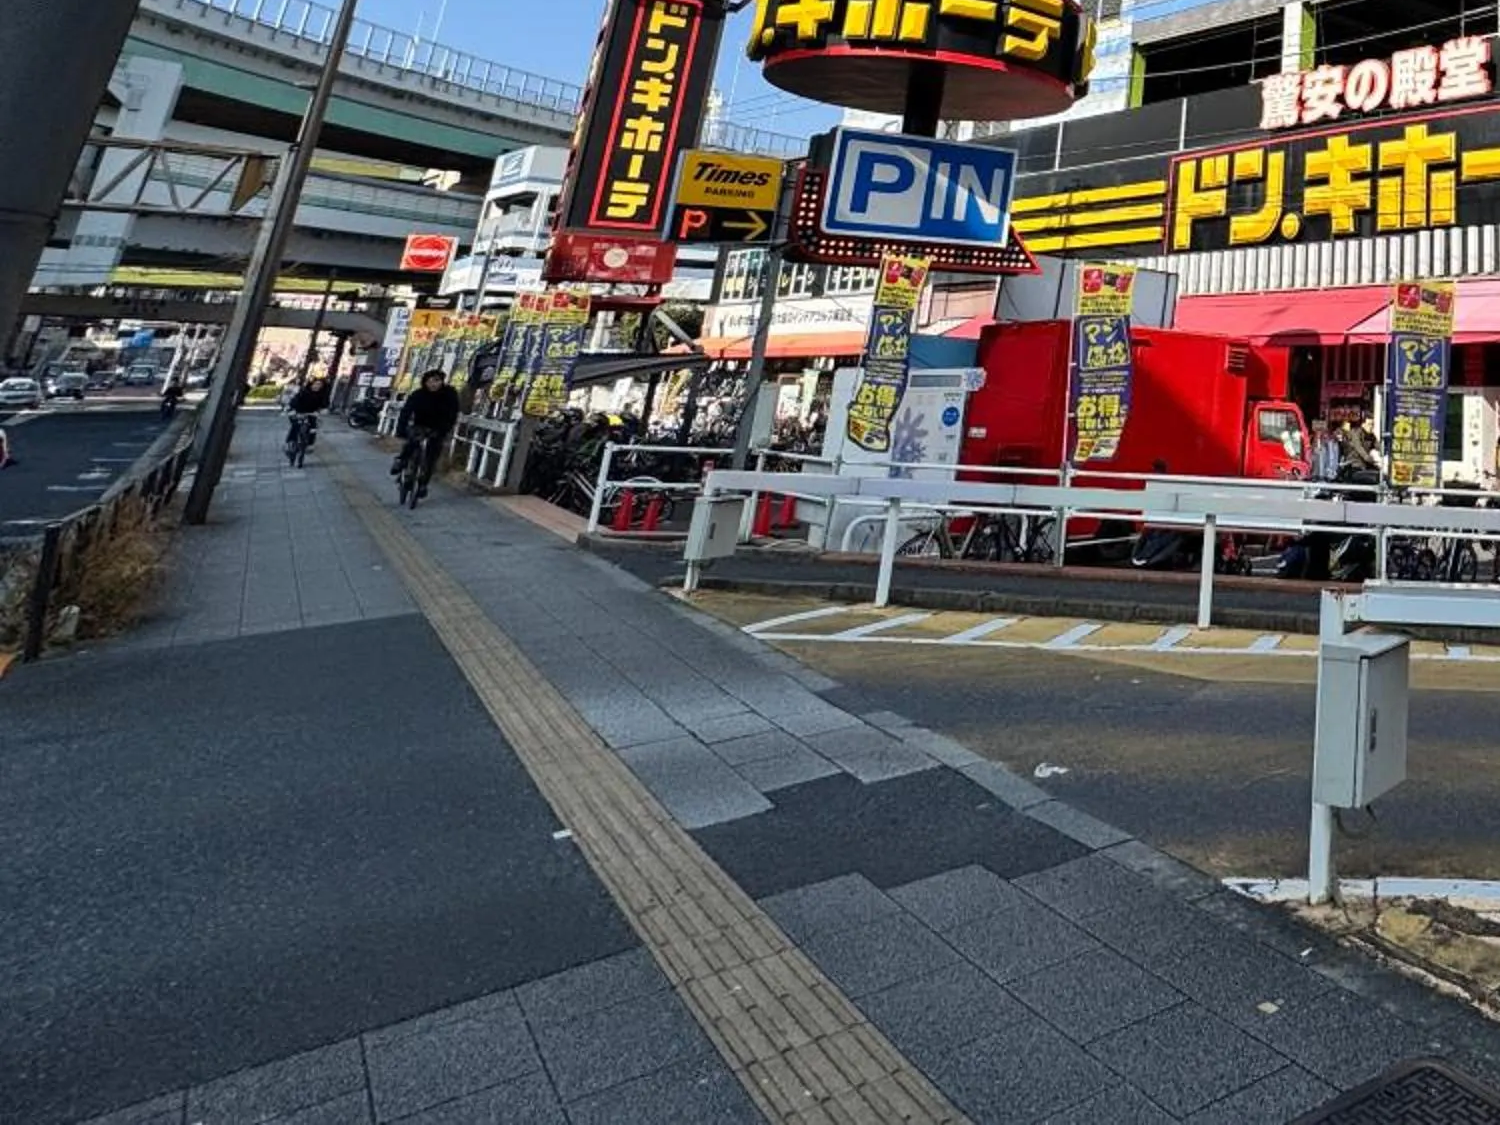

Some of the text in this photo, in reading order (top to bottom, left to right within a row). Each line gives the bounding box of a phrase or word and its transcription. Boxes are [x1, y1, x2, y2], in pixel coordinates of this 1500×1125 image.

[1259, 34, 1494, 131] 驚安の殿堂
[693, 161, 771, 186] Times
[849, 151, 1006, 224] P IN
[704, 187, 756, 200] PARKING
[679, 208, 707, 239] P
